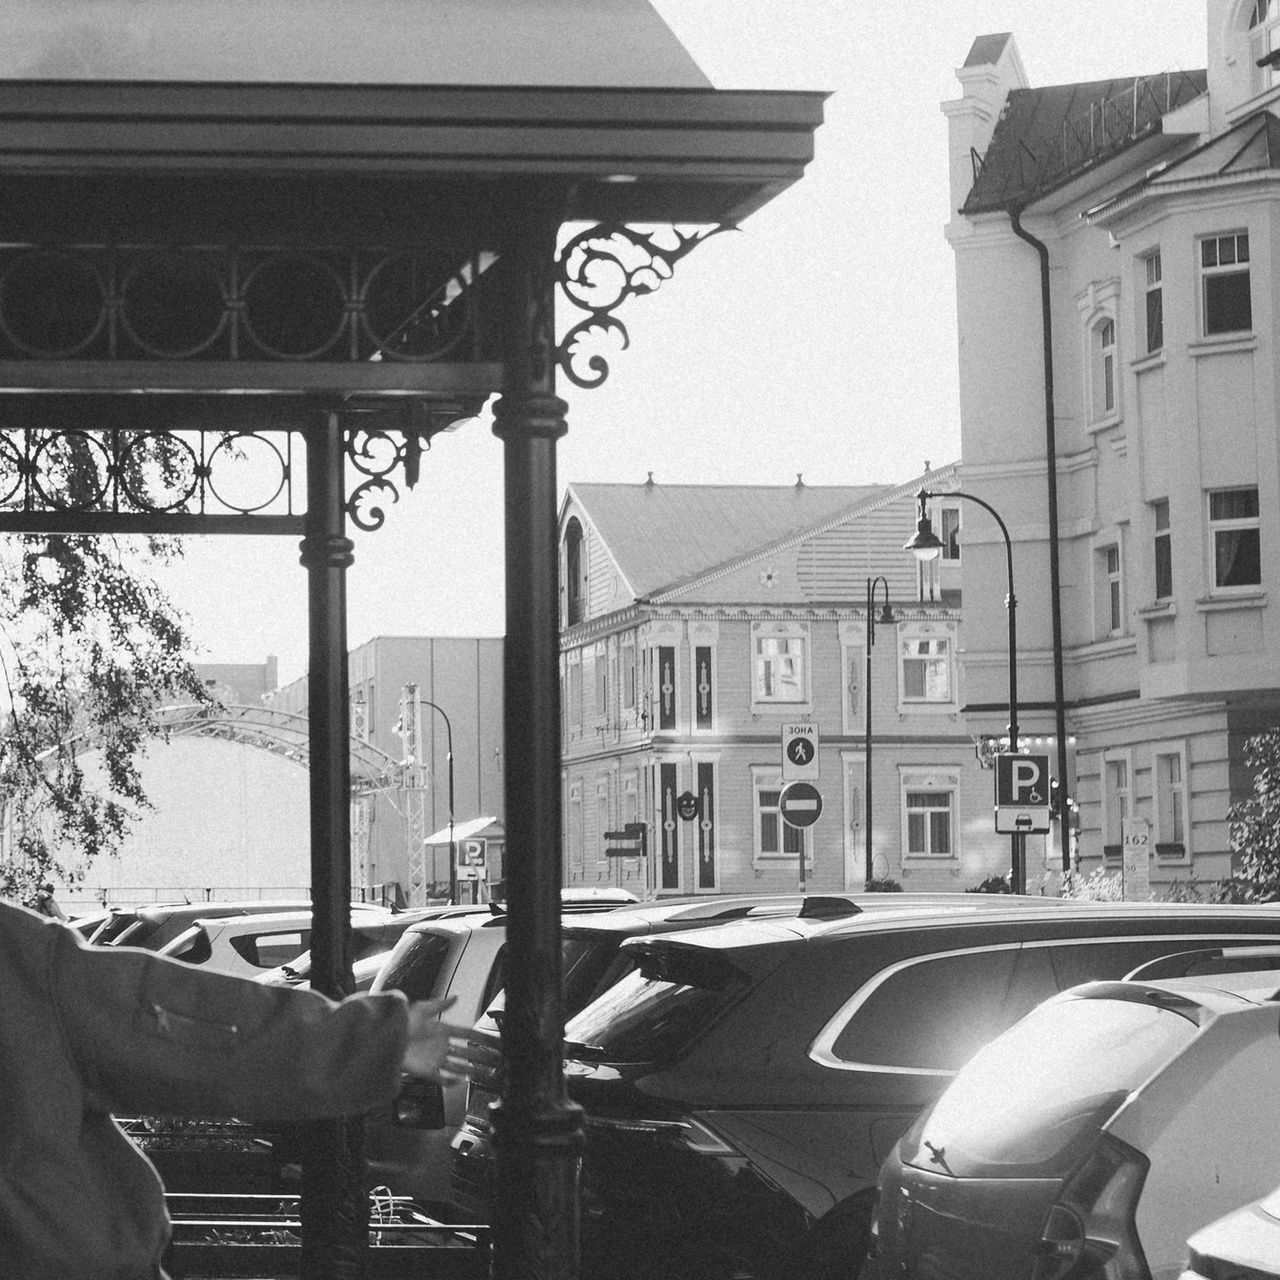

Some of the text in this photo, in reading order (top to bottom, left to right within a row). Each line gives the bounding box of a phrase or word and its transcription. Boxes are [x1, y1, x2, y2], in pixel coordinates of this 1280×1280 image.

[788, 726, 813, 735] ЗОНА
[1012, 760, 1040, 801] P
[1125, 834, 1148, 845] 162
[465, 841, 482, 865] P
